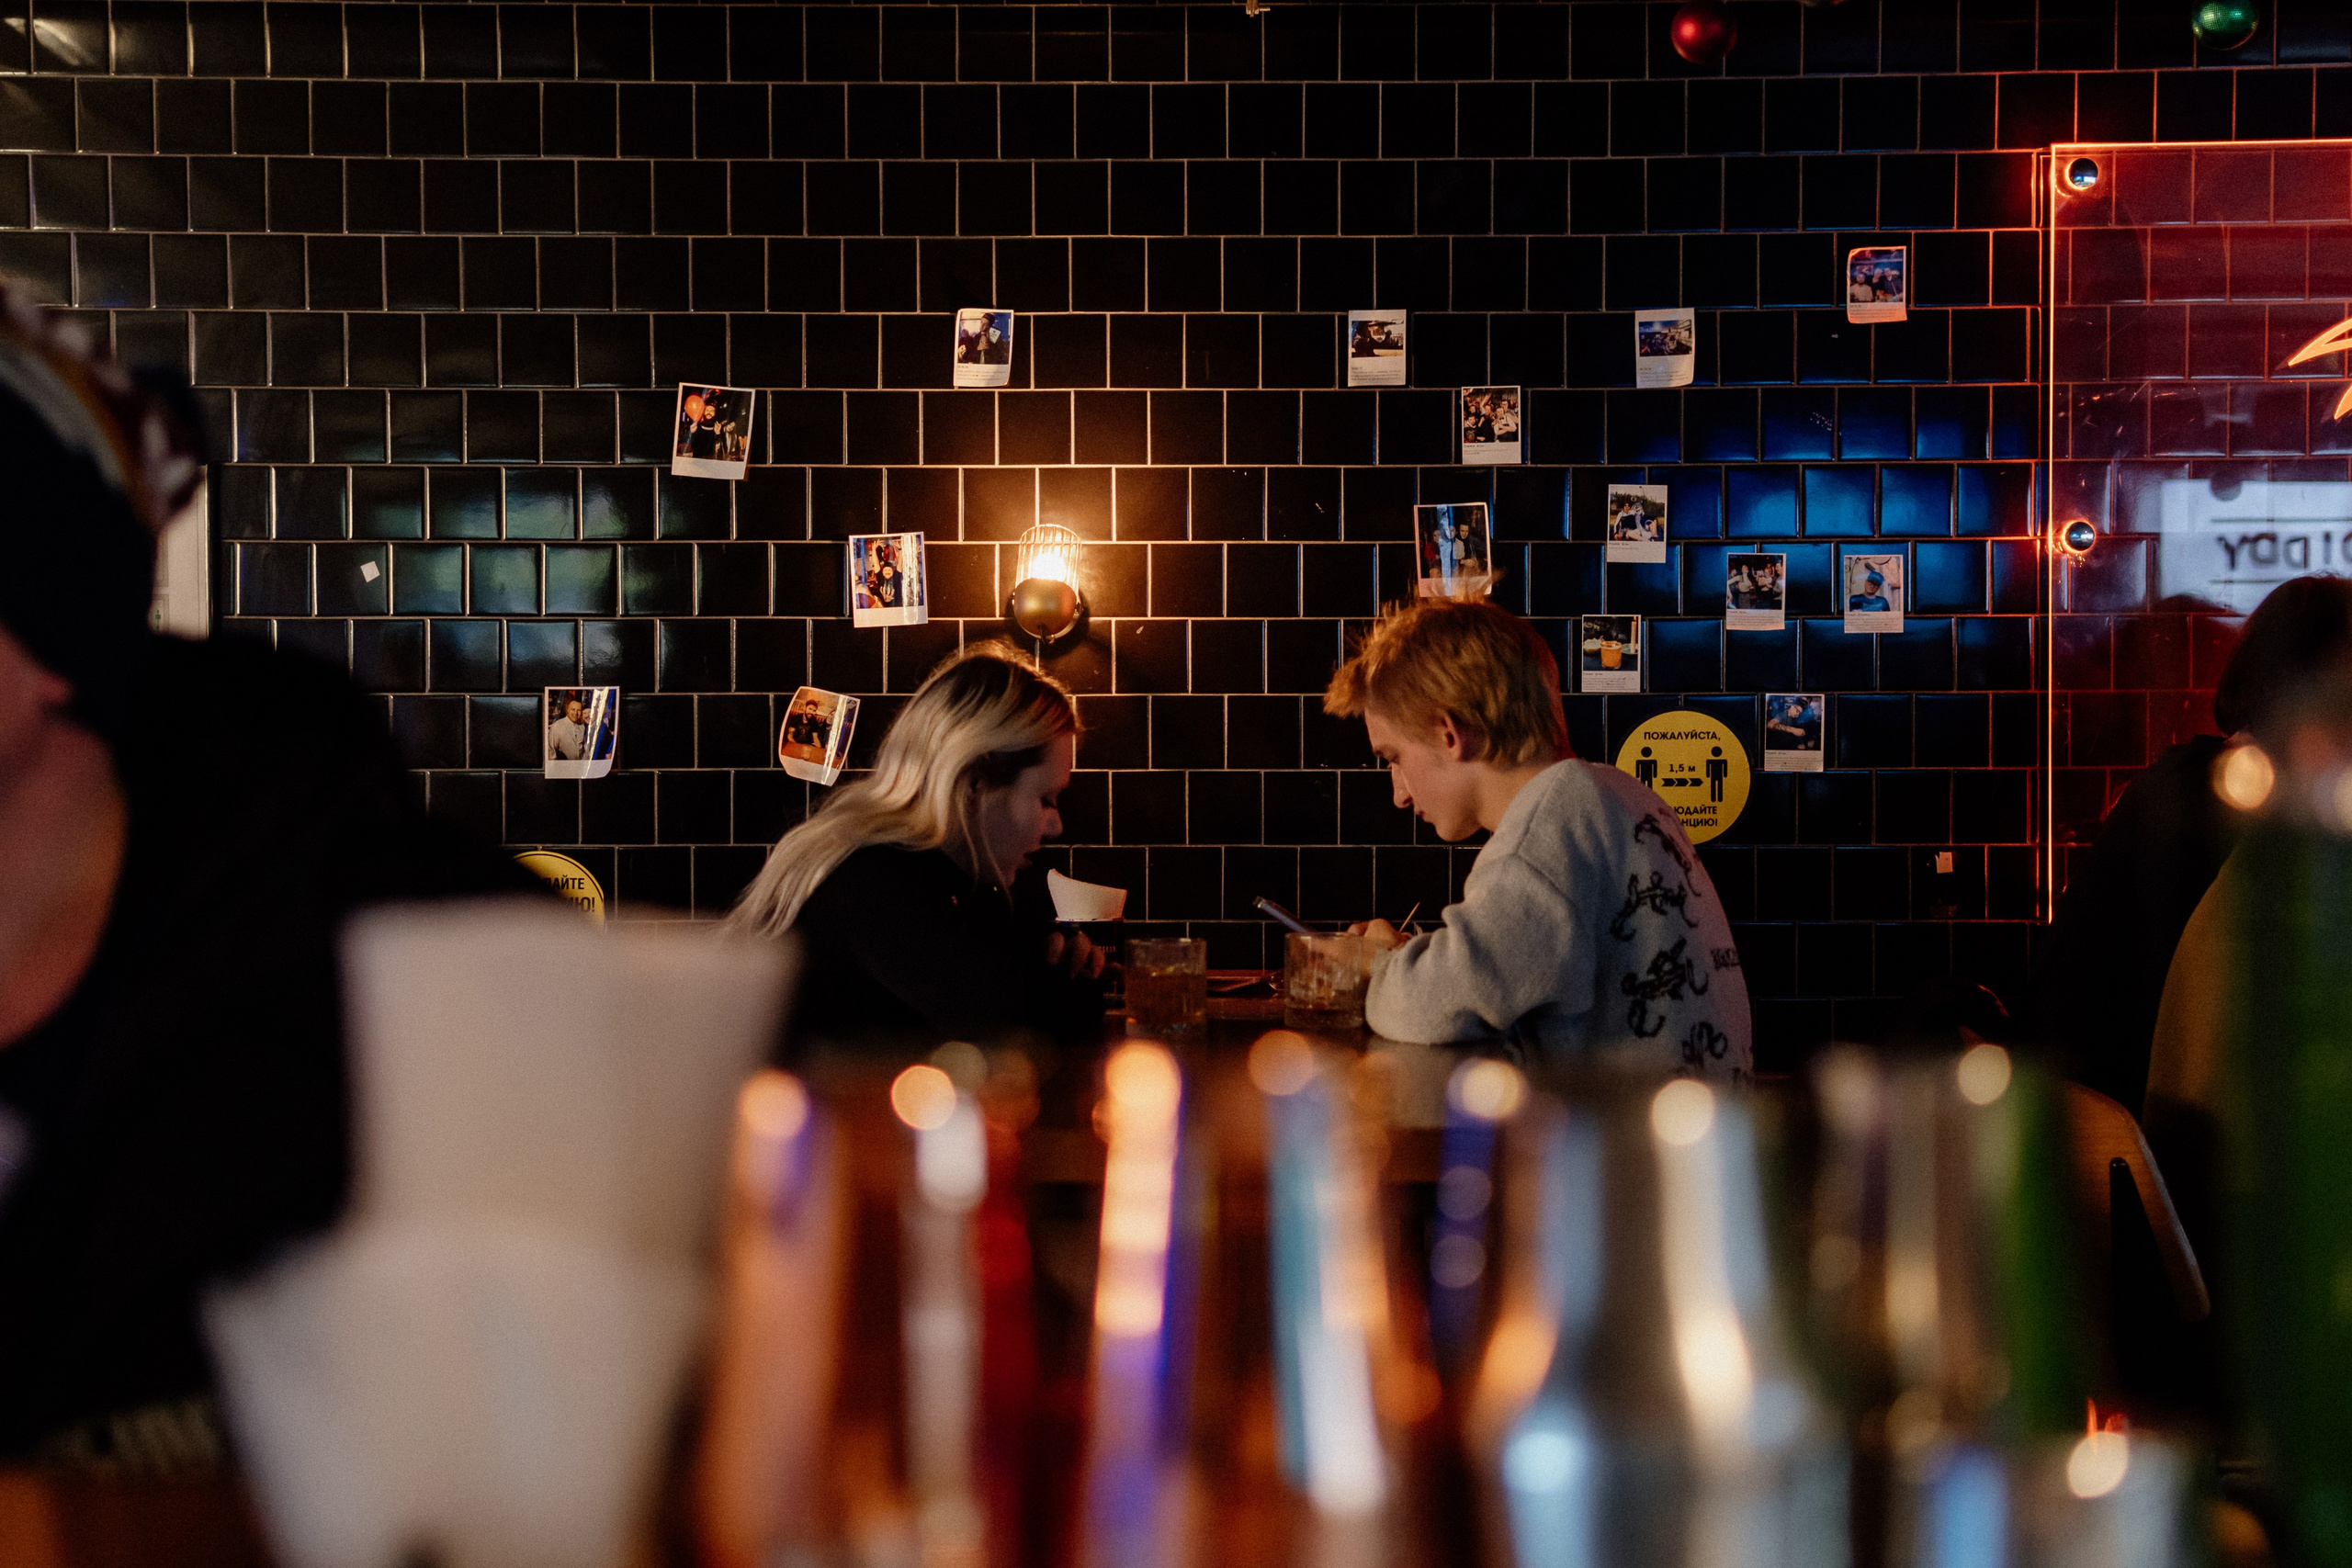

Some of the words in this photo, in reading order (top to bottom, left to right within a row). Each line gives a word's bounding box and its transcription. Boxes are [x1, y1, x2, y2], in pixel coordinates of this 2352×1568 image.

[1644, 729, 1721, 740] ПОЖАЛУЙСТА,
[1669, 763, 1685, 773] 1,5
[1674, 804, 1717, 816] ЮДАЙТЕ
[1681, 818, 1717, 828] НЦИЮ!
